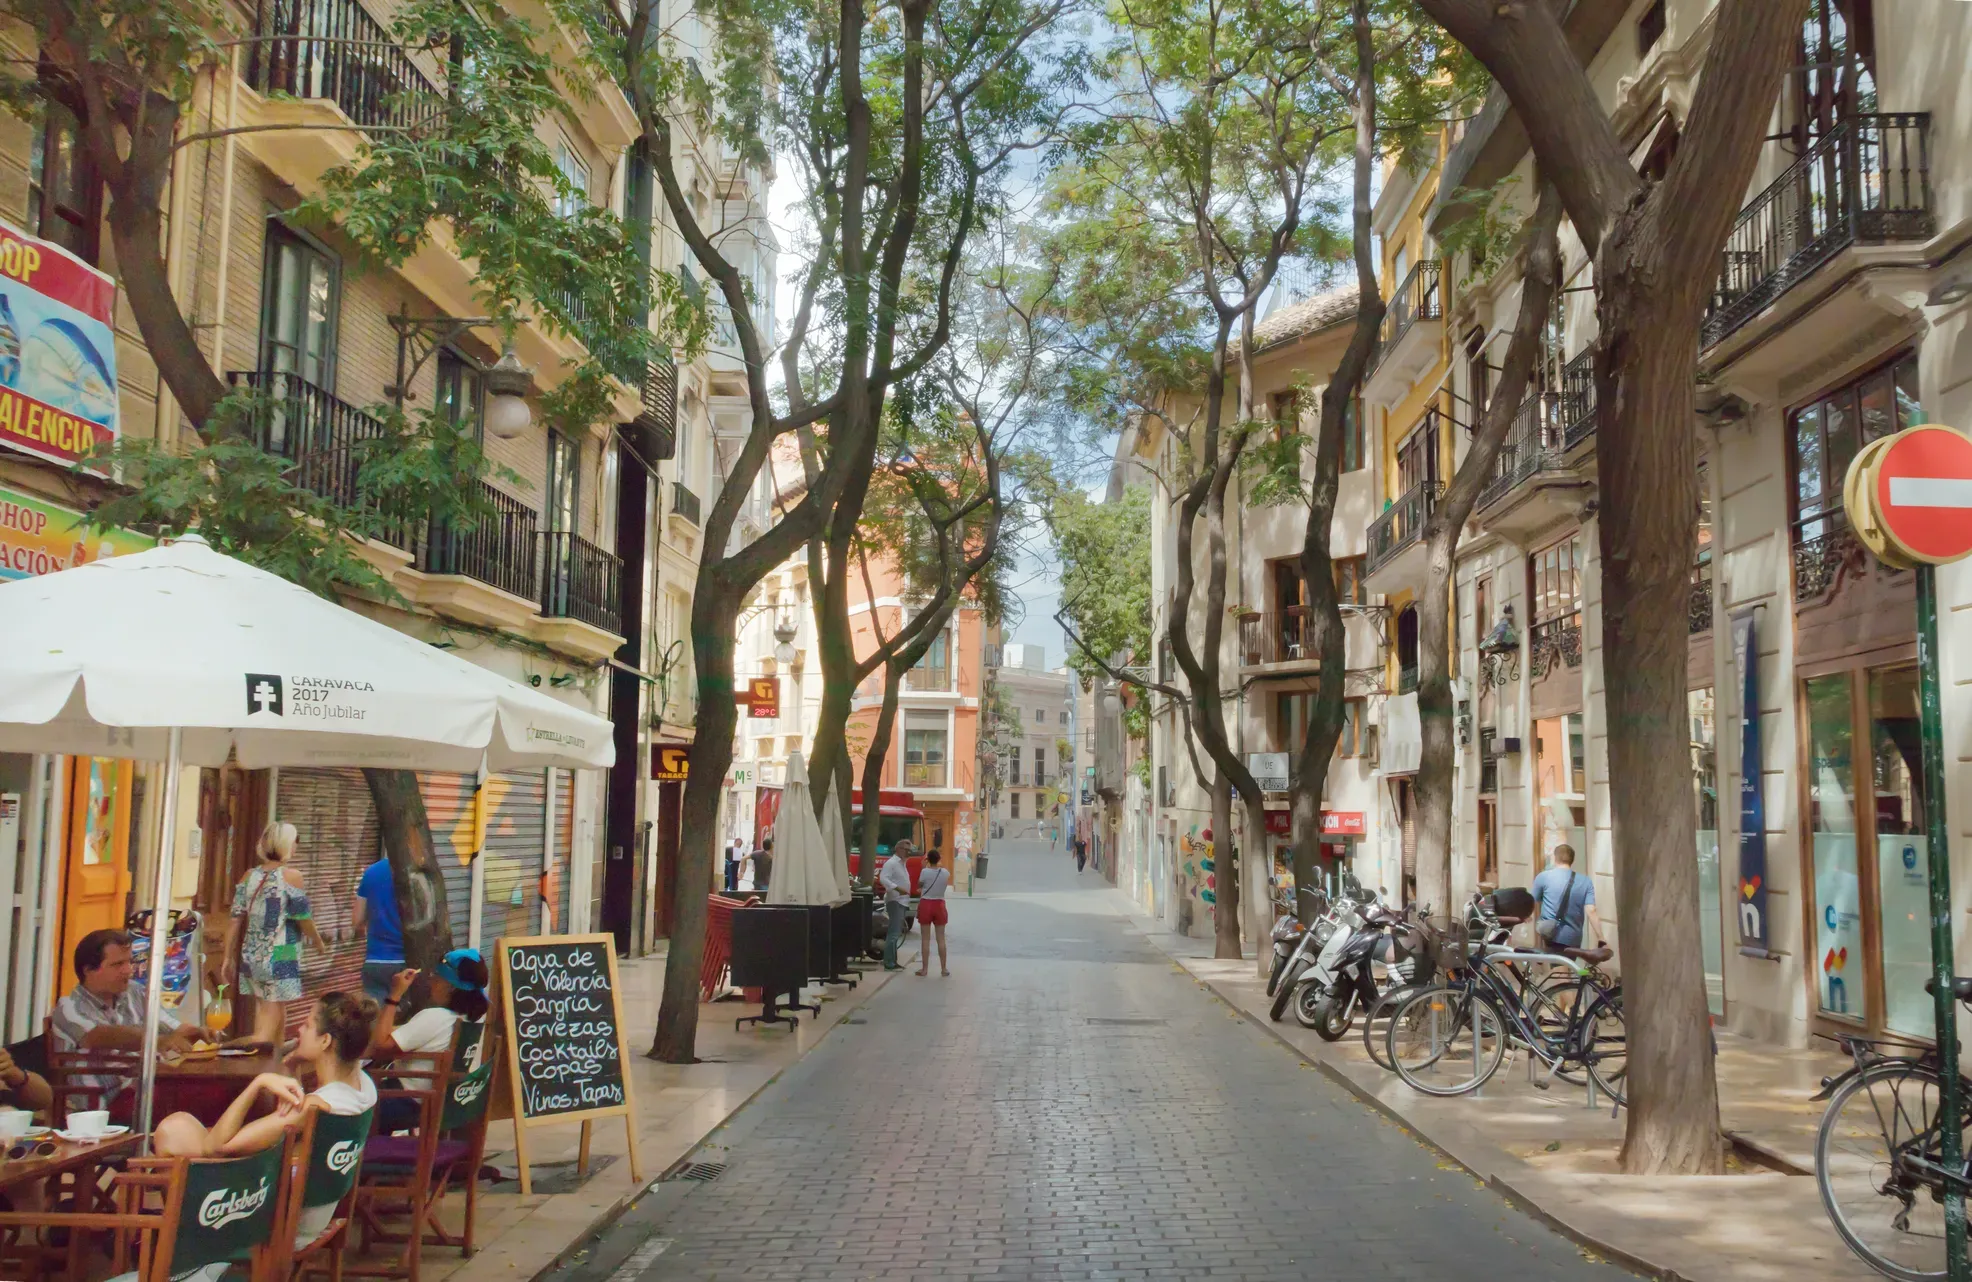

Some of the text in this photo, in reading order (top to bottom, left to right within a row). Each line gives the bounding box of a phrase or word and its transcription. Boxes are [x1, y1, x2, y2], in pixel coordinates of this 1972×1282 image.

[0, 232, 41, 282] OP
[0, 501, 47, 535] HOP
[291, 676, 375, 692] CARAVACA
[292, 688, 329, 702] 2017
[292, 702, 367, 720] Año Jubilar
[567, 947, 596, 968] de
[518, 1018, 613, 1039] Cervezas
[519, 1039, 619, 1063] Cocktails
[529, 1059, 603, 1083] Copas
[198, 1176, 271, 1230] Carlsberg
